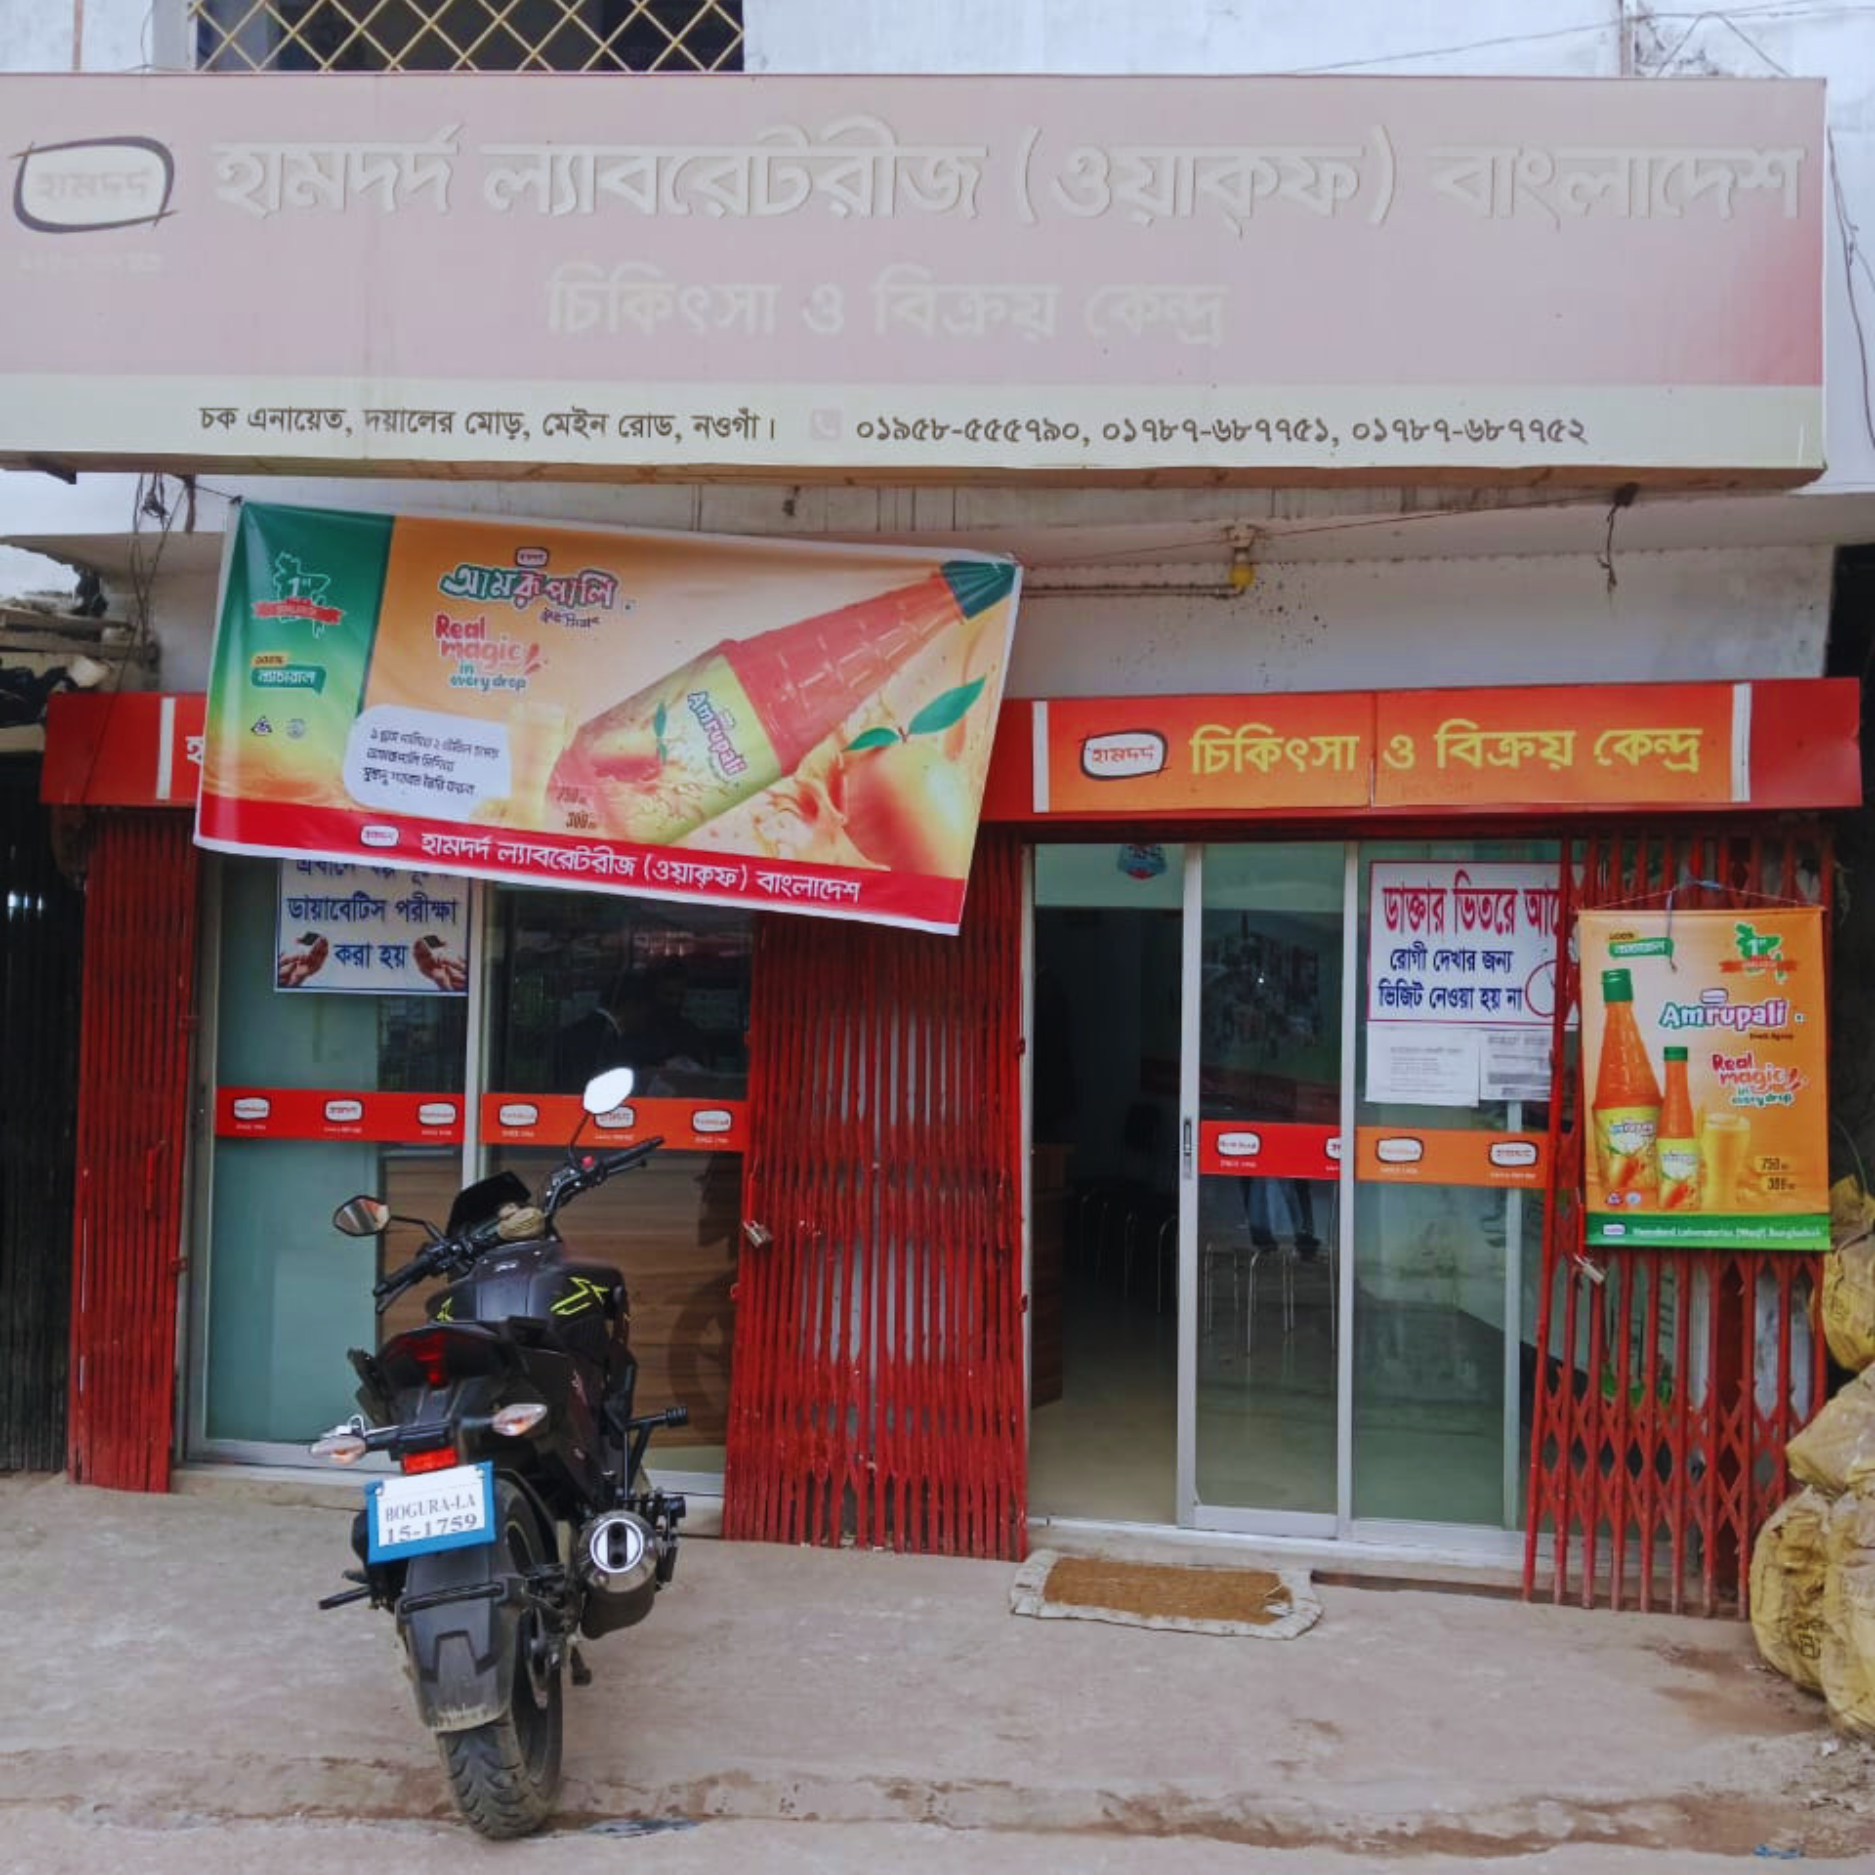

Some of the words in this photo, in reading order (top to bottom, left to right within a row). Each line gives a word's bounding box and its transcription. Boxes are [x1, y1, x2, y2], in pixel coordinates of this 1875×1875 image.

[211, 124, 463, 217] হামদর্দ
[480, 115, 989, 218] ল্যাবরেটরীজ
[1428, 144, 1808, 232] বাংলাদেশ
[544, 261, 780, 335] চিকিৎসা
[802, 285, 845, 335] ও
[867, 262, 1061, 342] বিক্রয়
[1087, 284, 1228, 347] কেন্দ্র
[199, 408, 239, 430] চক
[248, 407, 352, 437] এনায়েত,
[363, 408, 455, 434] দয়ালের
[465, 410, 530, 440] মোড়,
[542, 406, 609, 439] মেইন
[619, 411, 682, 443] রোড,
[856, 416, 1090, 447] ০১৯৫৮-৫৫৫৭৯০,
[1103, 417, 1339, 448] ০১৭৮৭-৬৮৭৭৫১,
[1352, 417, 1589, 445] ০১৭৮৭-৬৮৭৭৫২
[435, 615, 486, 640] Real
[441, 636, 522, 668] magic
[1090, 745, 1156, 764] হামদর্দ
[1189, 723, 1360, 775] চিকিৎসা
[1382, 734, 1416, 769] ও
[1433, 718, 1576, 771] বিক্রয়
[1594, 728, 1704, 773] কেন্দ্র
[421, 832, 492, 860] হামদর্দ
[497, 842, 638, 877] ল্যাবরেটরীজ
[756, 870, 861, 902] বাংলাদেশ
[287, 890, 388, 923] ডায়াবেটিস
[395, 891, 458, 925] পরীক্ষা
[1382, 880, 1448, 936] ডাক্তার
[1452, 869, 1518, 936] ভিতরে
[334, 941, 374, 969] করা
[378, 944, 410, 969] হয়
[1390, 940, 1427, 972] রোগী
[1433, 947, 1476, 972] দেখার
[1482, 950, 1515, 974] জন্য
[1378, 977, 1424, 1009] ভিজিট
[1429, 985, 1475, 1010] নেওয়া
[1480, 986, 1503, 1012] হয়
[1506, 986, 1523, 1012] না
[1660, 1000, 1788, 1031] Amrupali
[1711, 1053, 1753, 1071] Real
[1720, 1063, 1788, 1091] magic
[385, 1494, 477, 1521] BOGURA-LA
[388, 1513, 477, 1544] 15-1759
